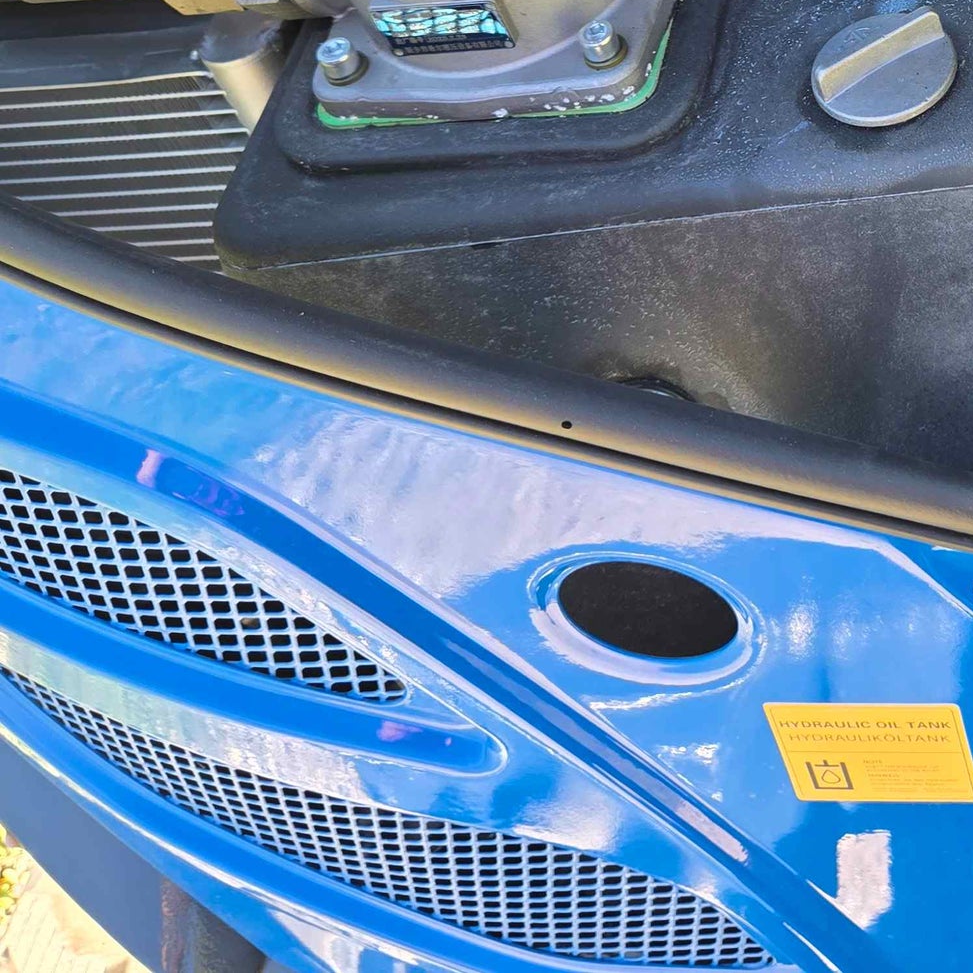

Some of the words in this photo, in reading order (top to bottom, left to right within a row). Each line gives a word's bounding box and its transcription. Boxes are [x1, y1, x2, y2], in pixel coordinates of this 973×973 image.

[779, 720, 871, 729] HYDRAULIC
[876, 720, 901, 729] OIL
[906, 720, 951, 729] TANK
